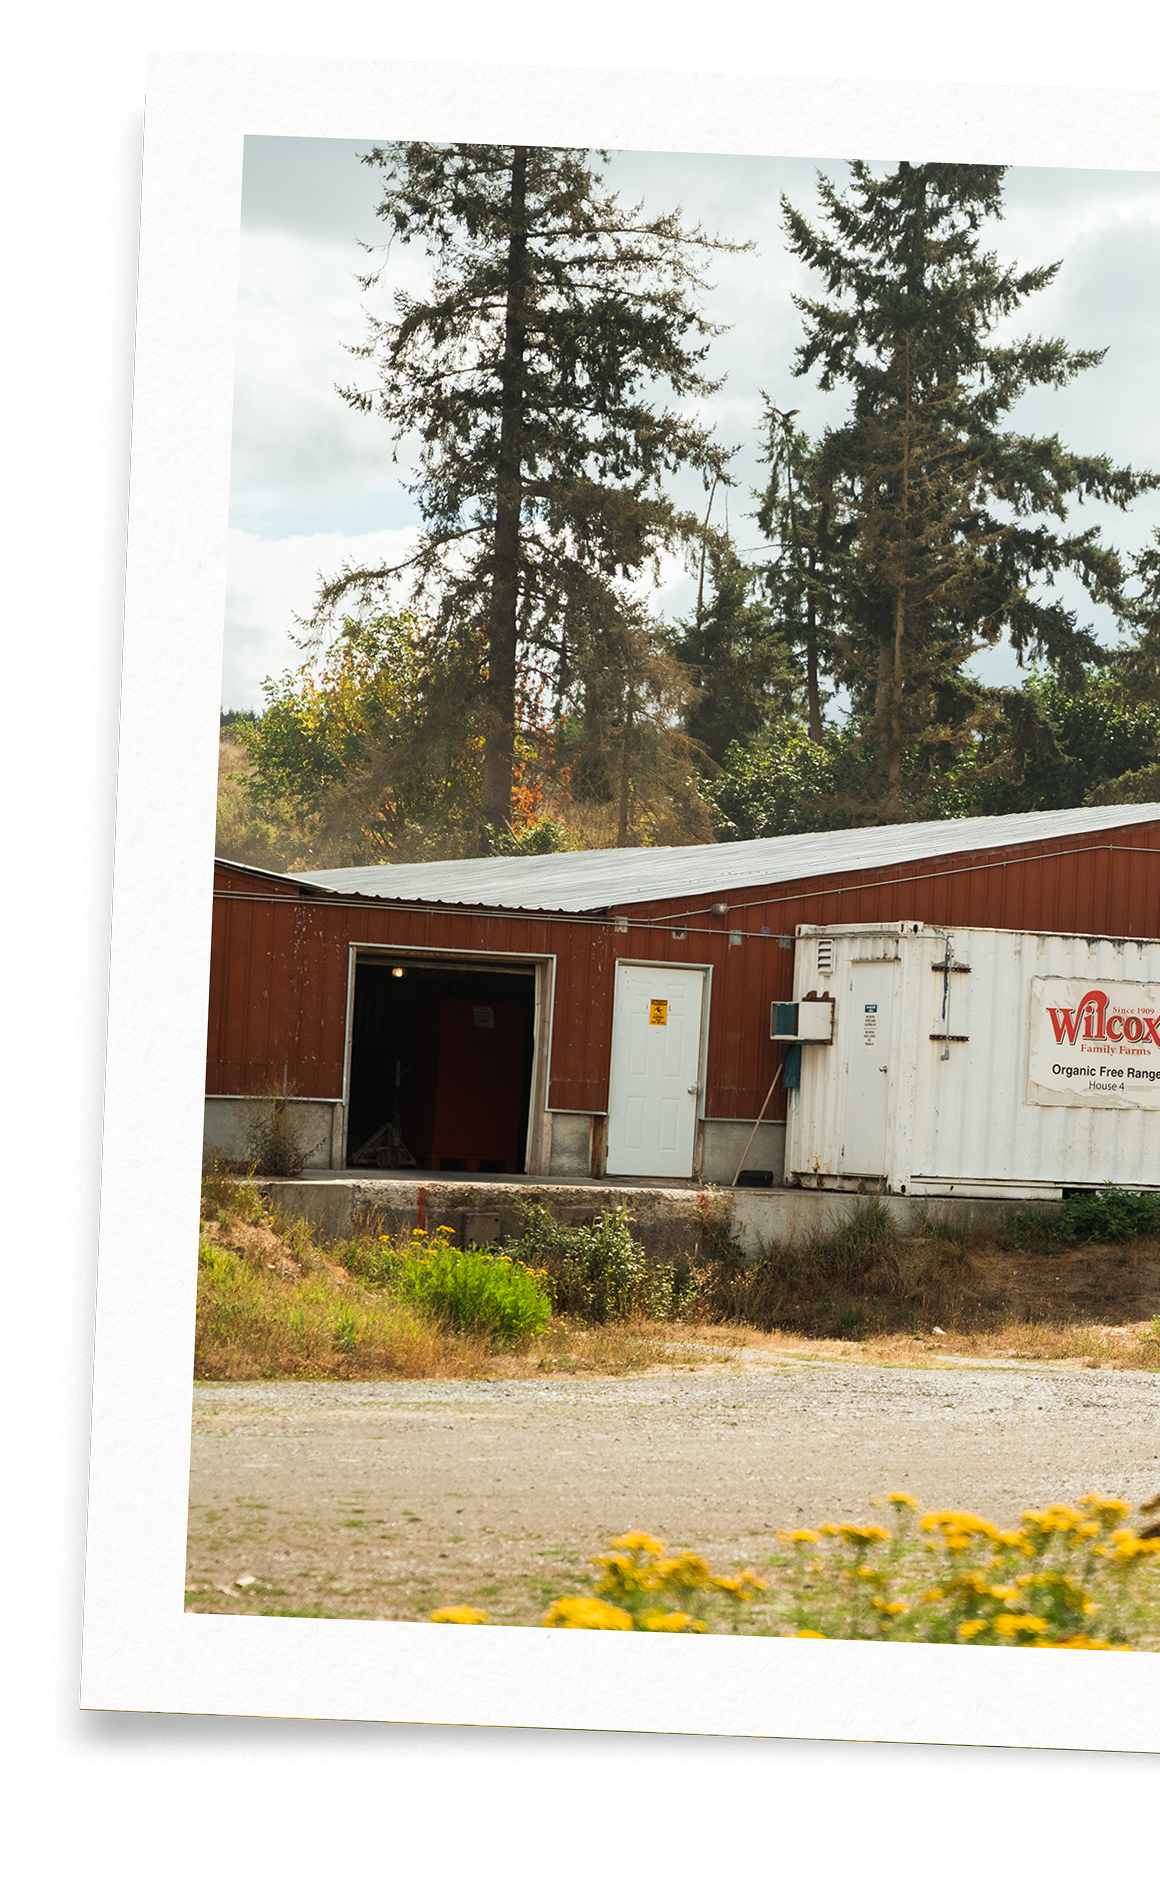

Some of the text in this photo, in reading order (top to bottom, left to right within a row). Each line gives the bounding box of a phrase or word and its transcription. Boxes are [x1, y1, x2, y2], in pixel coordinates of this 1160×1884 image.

[1112, 1006, 1155, 1015] Since 1909
[1080, 1044, 1151, 1056] Family Farms
[1052, 1063, 1096, 1078] Organic
[1099, 1066, 1124, 1078] Free
[1088, 1080, 1125, 1091] House 4
